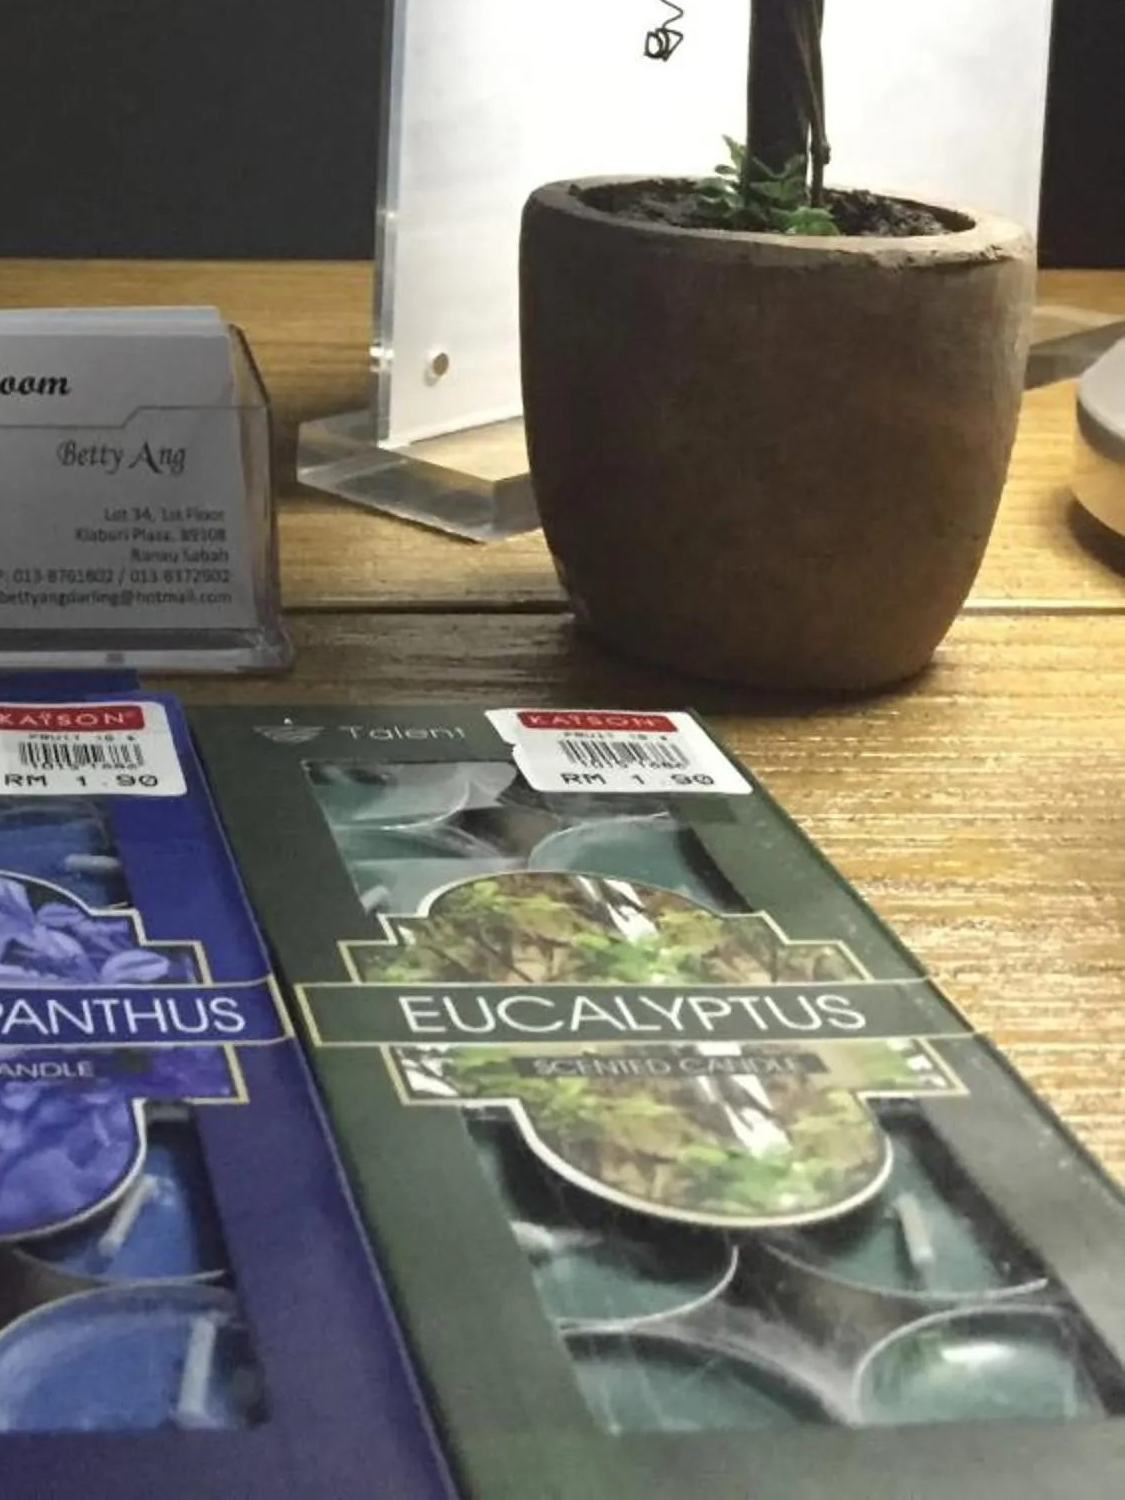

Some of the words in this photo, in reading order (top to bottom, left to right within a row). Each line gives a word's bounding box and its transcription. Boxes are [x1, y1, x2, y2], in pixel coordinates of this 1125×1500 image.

[57, 438, 124, 475] Betty
[128, 440, 187, 476] Ang
[337, 723, 467, 741] Talent
[5, 774, 48, 787] RM
[561, 773, 608, 785] RM
[399, 995, 867, 1033] EUCALYPTUS
